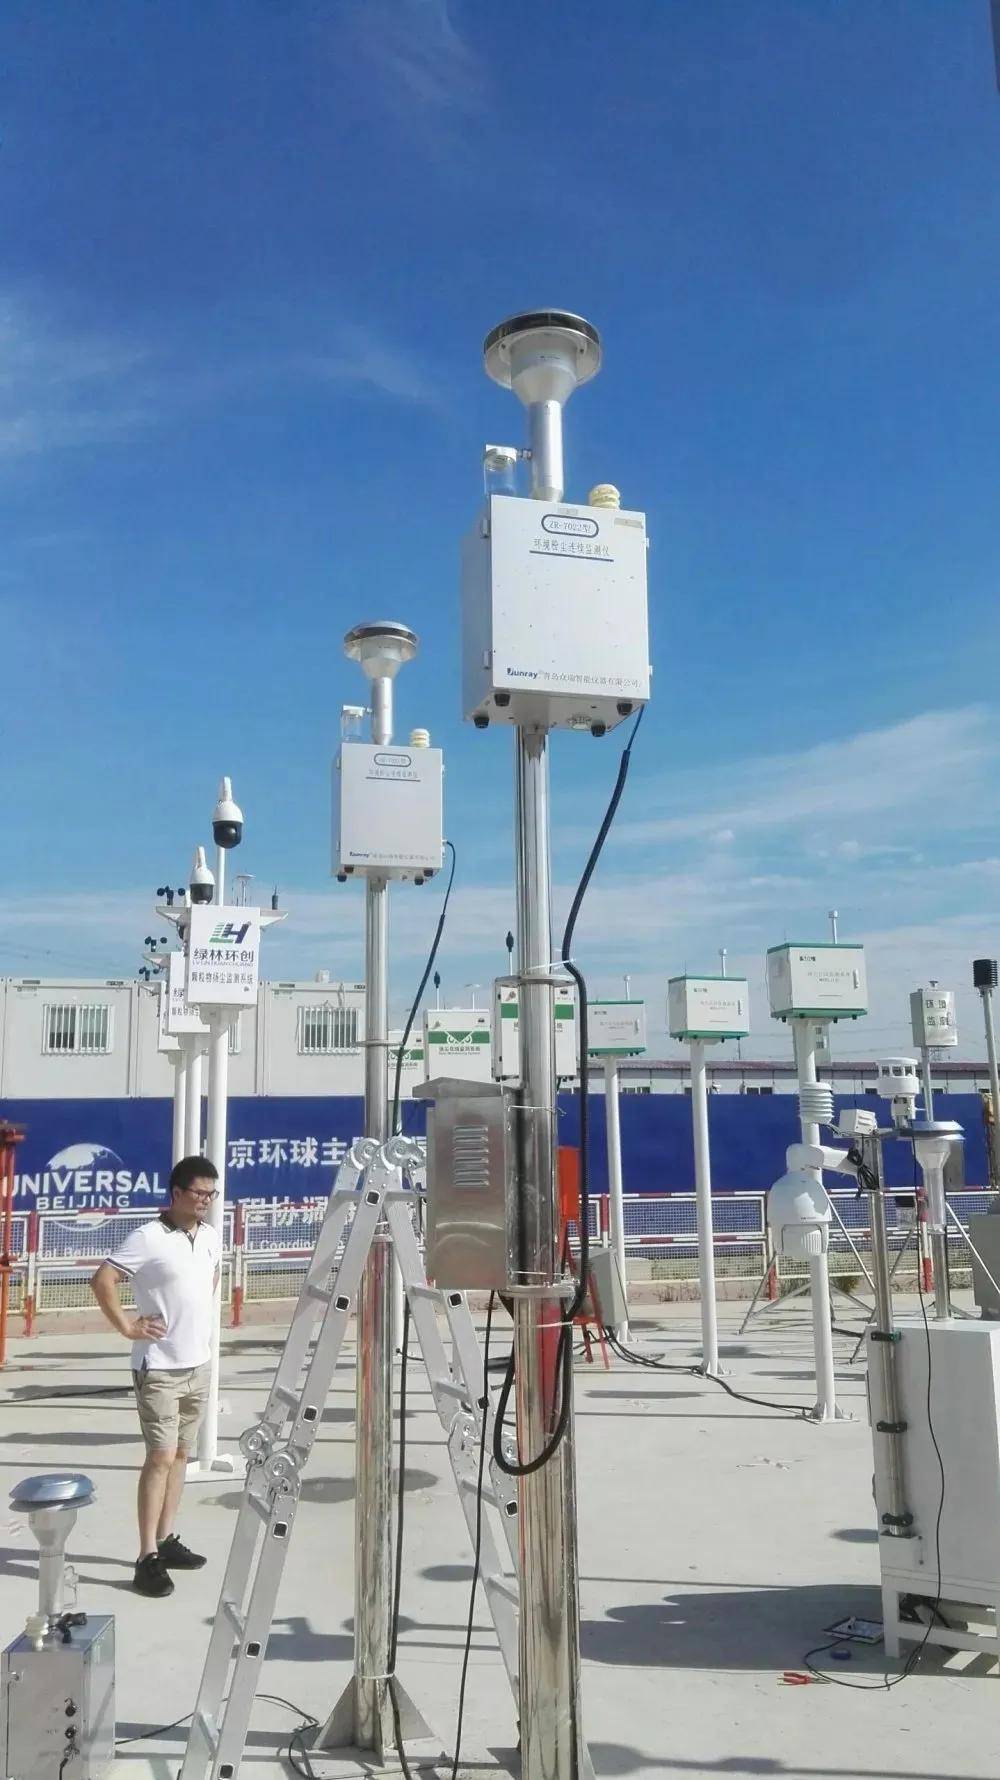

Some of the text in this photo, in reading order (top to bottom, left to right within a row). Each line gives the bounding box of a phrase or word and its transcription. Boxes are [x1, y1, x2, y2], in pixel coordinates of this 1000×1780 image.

[193, 948, 255, 963] 绿林环创
[2, 1169, 167, 1197] UNIVERSAL
[35, 1194, 130, 1210] BEIJING
